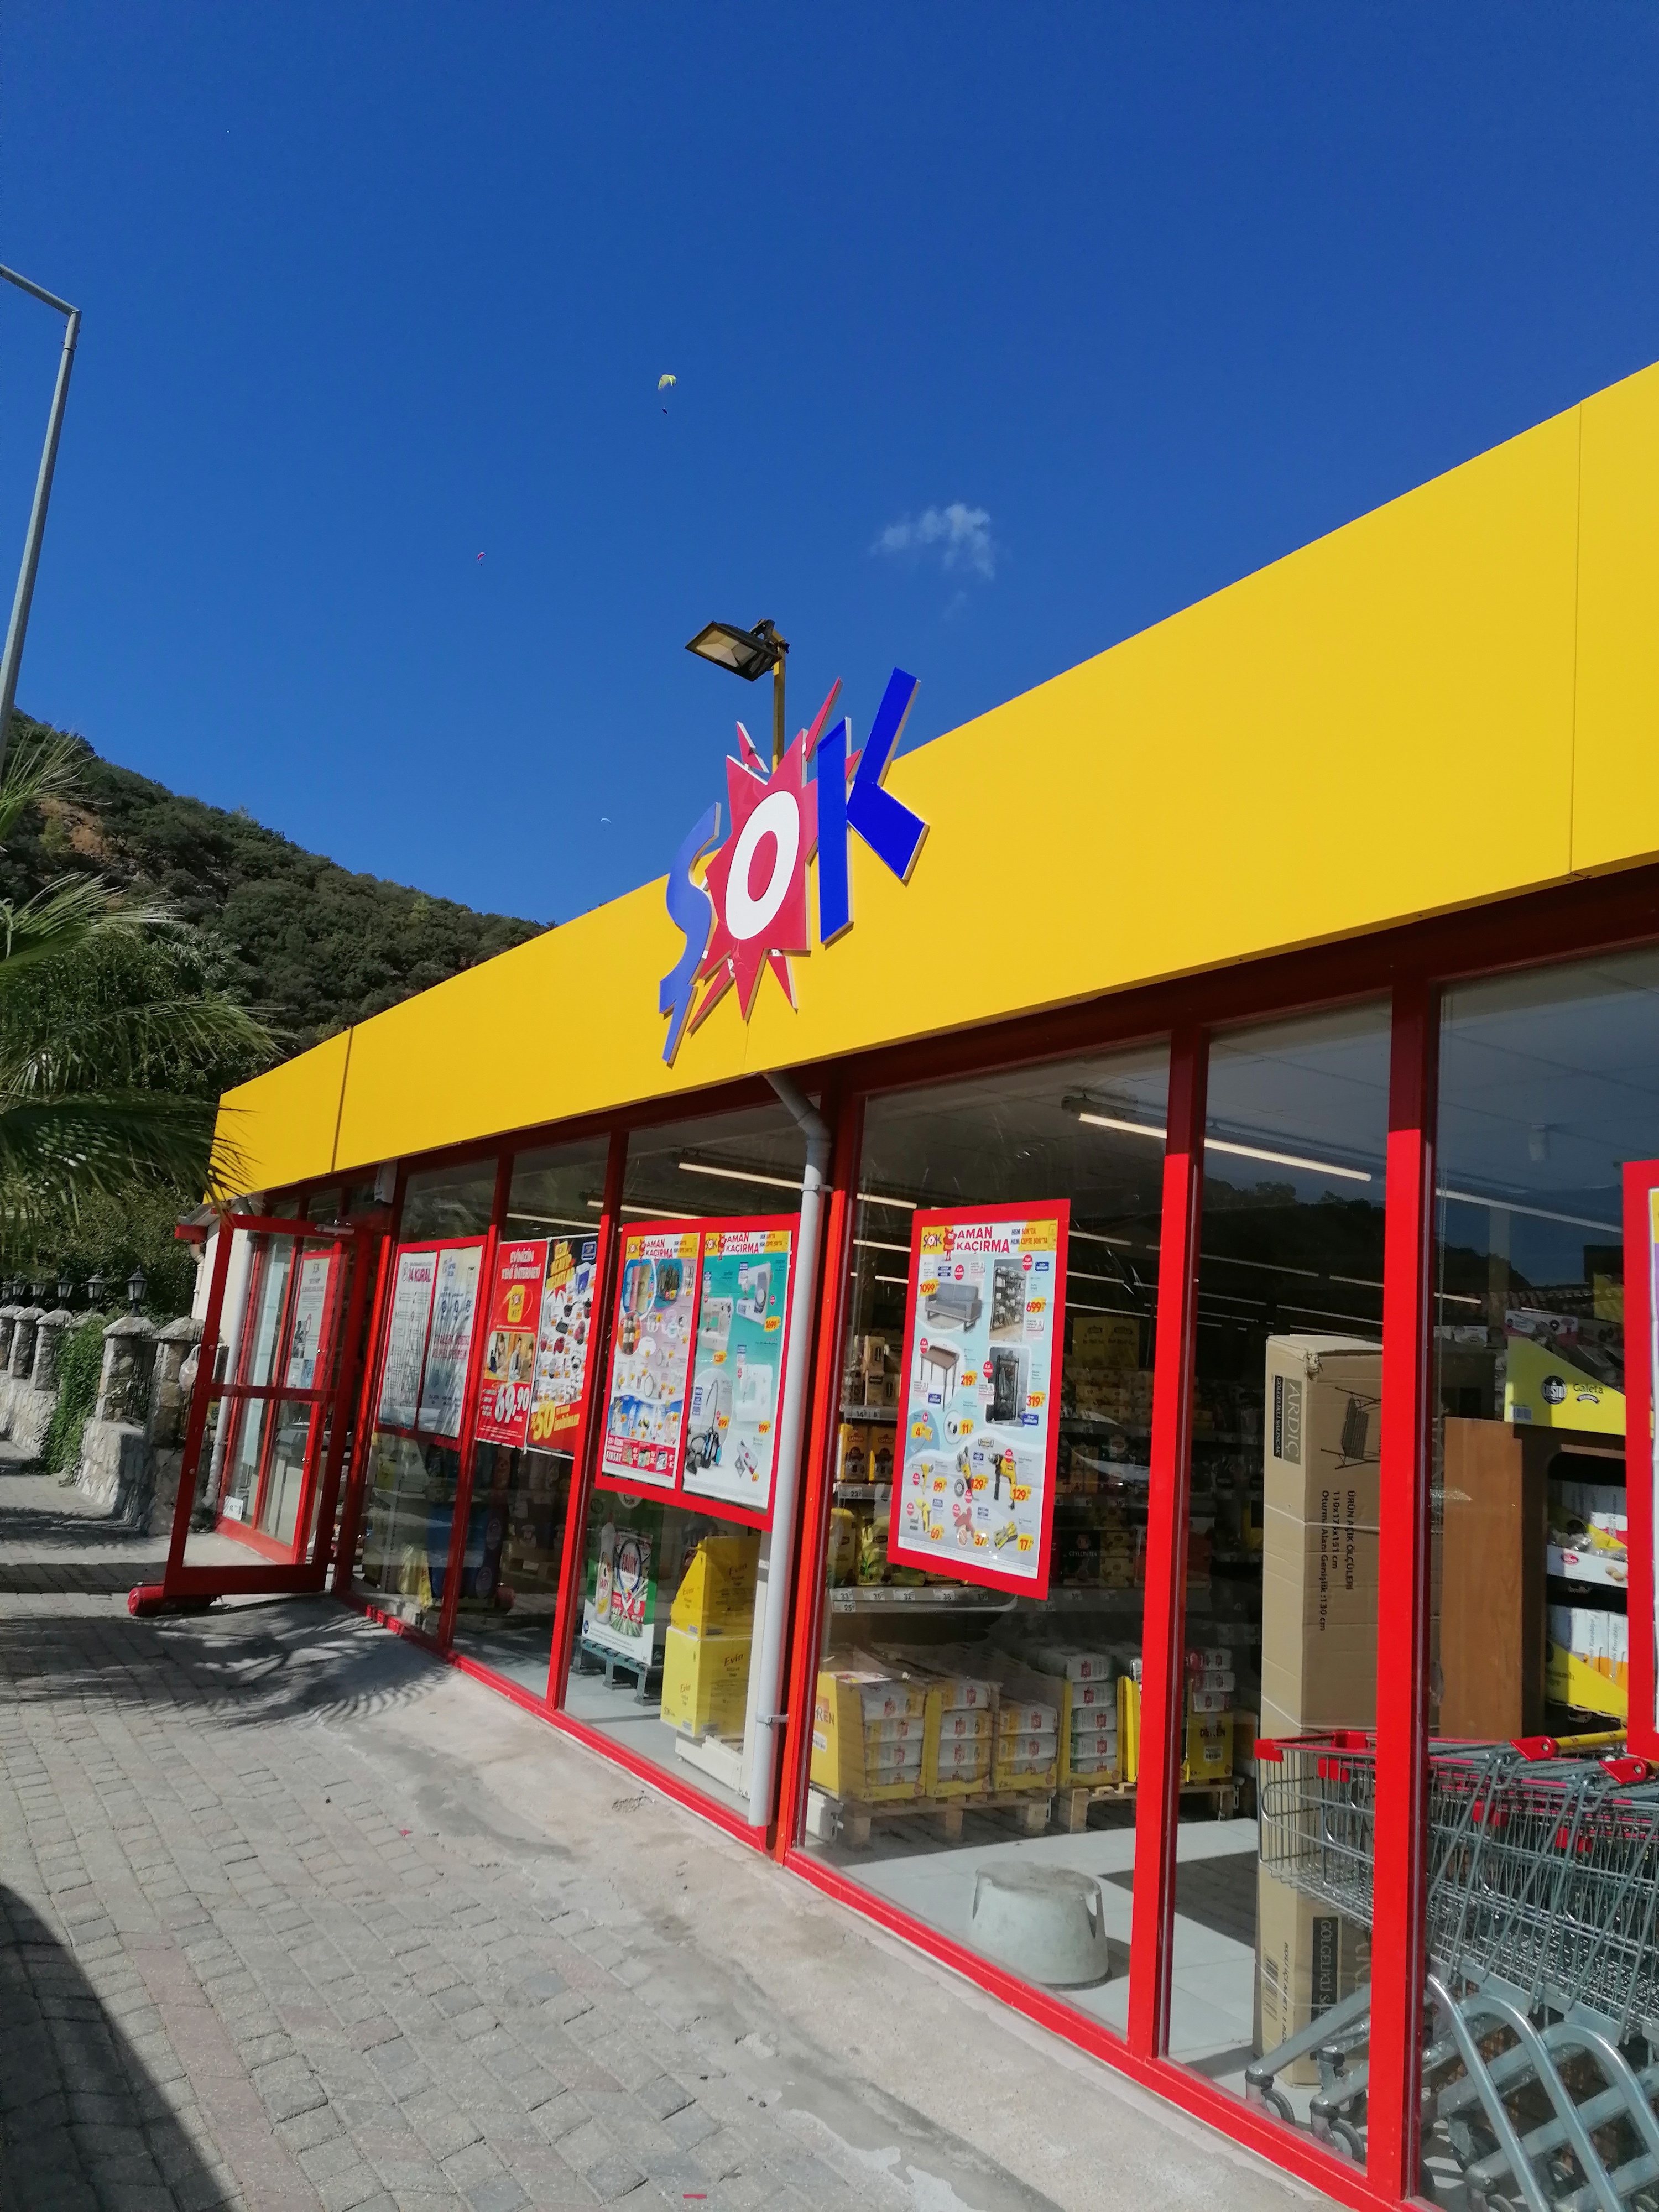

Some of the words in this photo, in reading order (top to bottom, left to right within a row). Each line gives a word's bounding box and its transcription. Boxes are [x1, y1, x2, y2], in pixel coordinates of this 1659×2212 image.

[727, 1232, 749, 1243] AMAN
[957, 1226, 993, 1239] AMAN
[646, 1239, 665, 1248] AMAN
[726, 1242, 759, 1255] KAÇIRMA
[957, 1239, 1009, 1254] KAÇIRMA
[920, 1283, 935, 1293] 1099
[1026, 1302, 1041, 1312] 699
[961, 1374, 973, 1386] 219
[1573, 1383, 1604, 1394] Galeta
[1027, 1395, 1040, 1407] 319
[1285, 1383, 1300, 1458] ARDIÇ
[933, 1480, 942, 1491] 89
[971, 1478, 984, 1490] 129
[1013, 1489, 1026, 1501] 129
[1347, 1490, 1357, 1518] ÜRÜN
[930, 1528, 939, 1540] 69
[1020, 1538, 1029, 1550] 17
[622, 1552, 638, 1575] FAIRY
[1332, 1554, 1338, 1569] cm
[1344, 1545, 1355, 1590] ÖLÇÜLERİ
[1318, 1555, 1328, 1593] Genişlik
[1319, 1617, 1326, 1631] cm
[724, 1653, 744, 1667] Evin
[816, 1704, 836, 1729] REN
[1319, 1919, 1333, 1991] GÖLGELİKLİ
